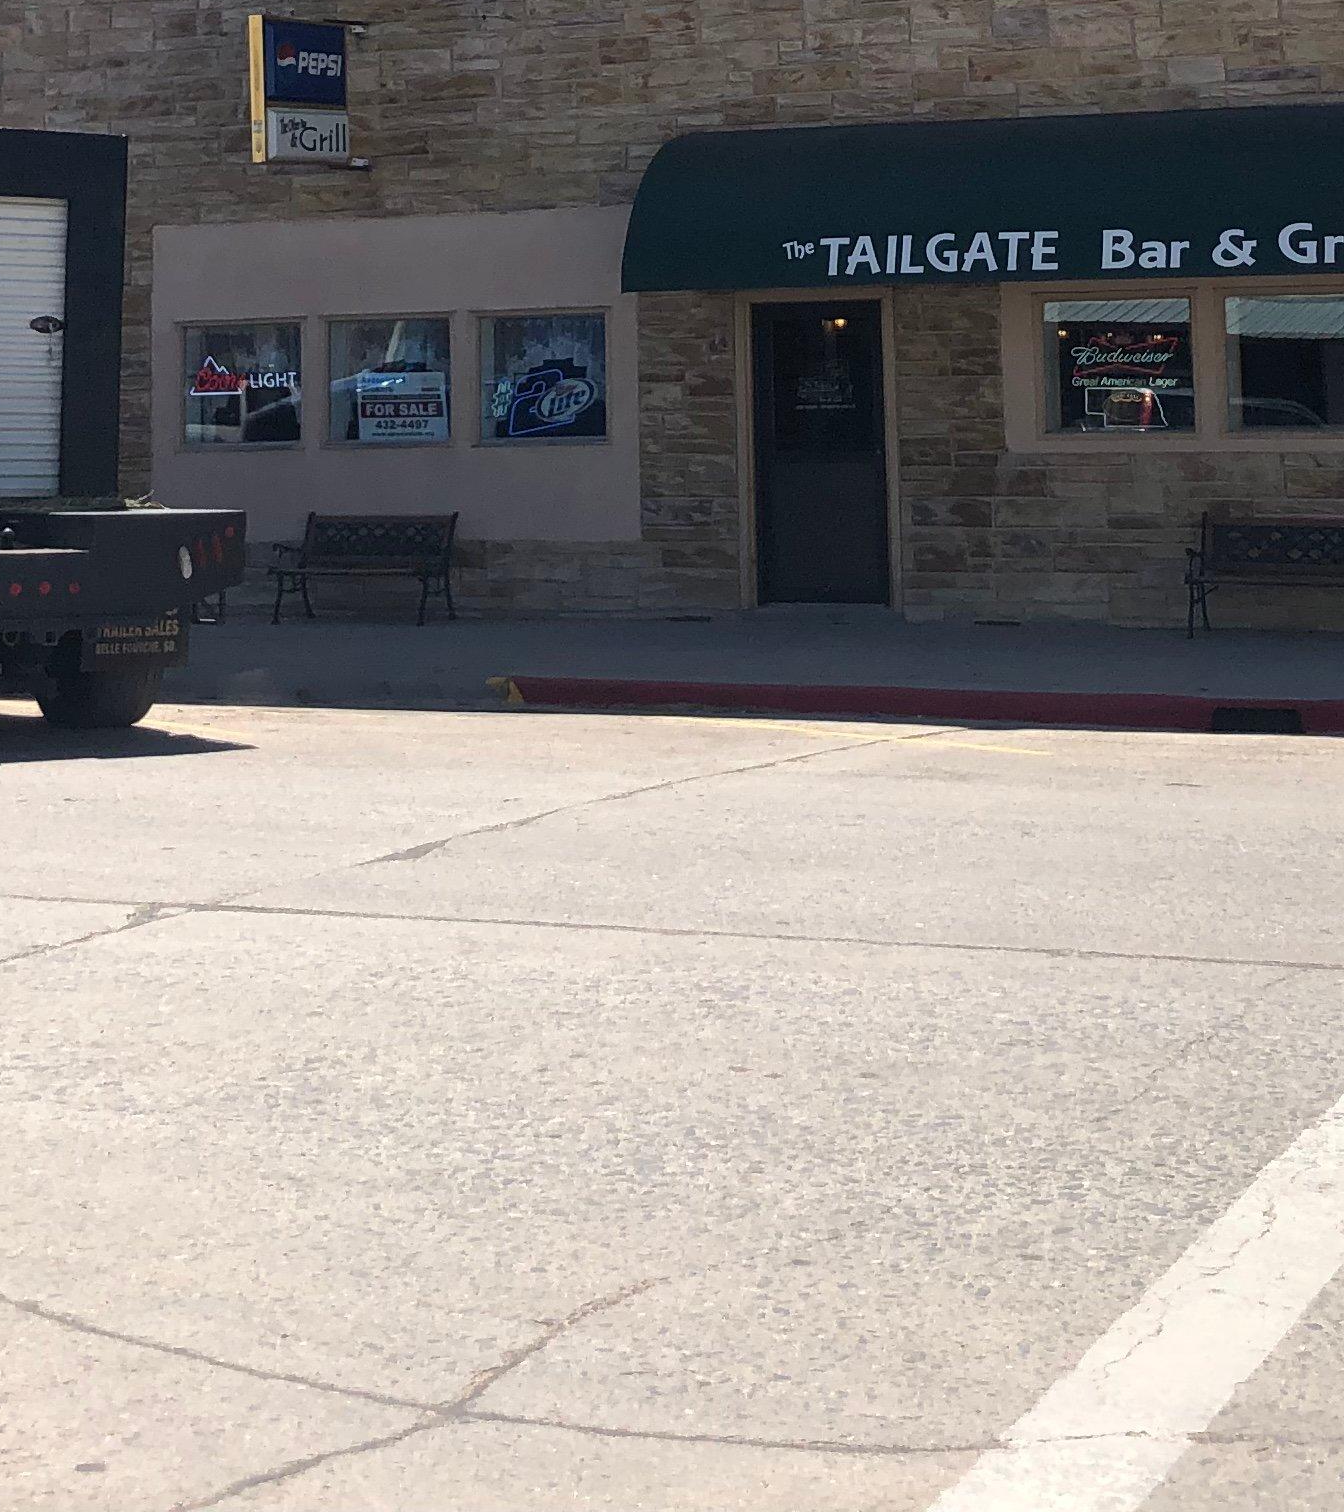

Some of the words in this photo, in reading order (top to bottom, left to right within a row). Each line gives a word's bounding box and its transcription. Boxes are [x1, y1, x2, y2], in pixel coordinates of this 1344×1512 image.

[297, 51, 343, 77] PEPSI
[299, 122, 347, 153] Grill
[782, 239, 815, 263] The
[819, 230, 1059, 276] TAILGATE
[1100, 228, 1190, 270] Bar
[1210, 228, 1257, 268] &
[1071, 347, 1174, 365] Budweiser
[249, 371, 297, 389] LIGHT
[1071, 376, 1098, 387] Great
[1100, 376, 1147, 387] American
[1148, 376, 1178, 389] Lager
[365, 403, 395, 416] FOR
[398, 402, 438, 416] SALE
